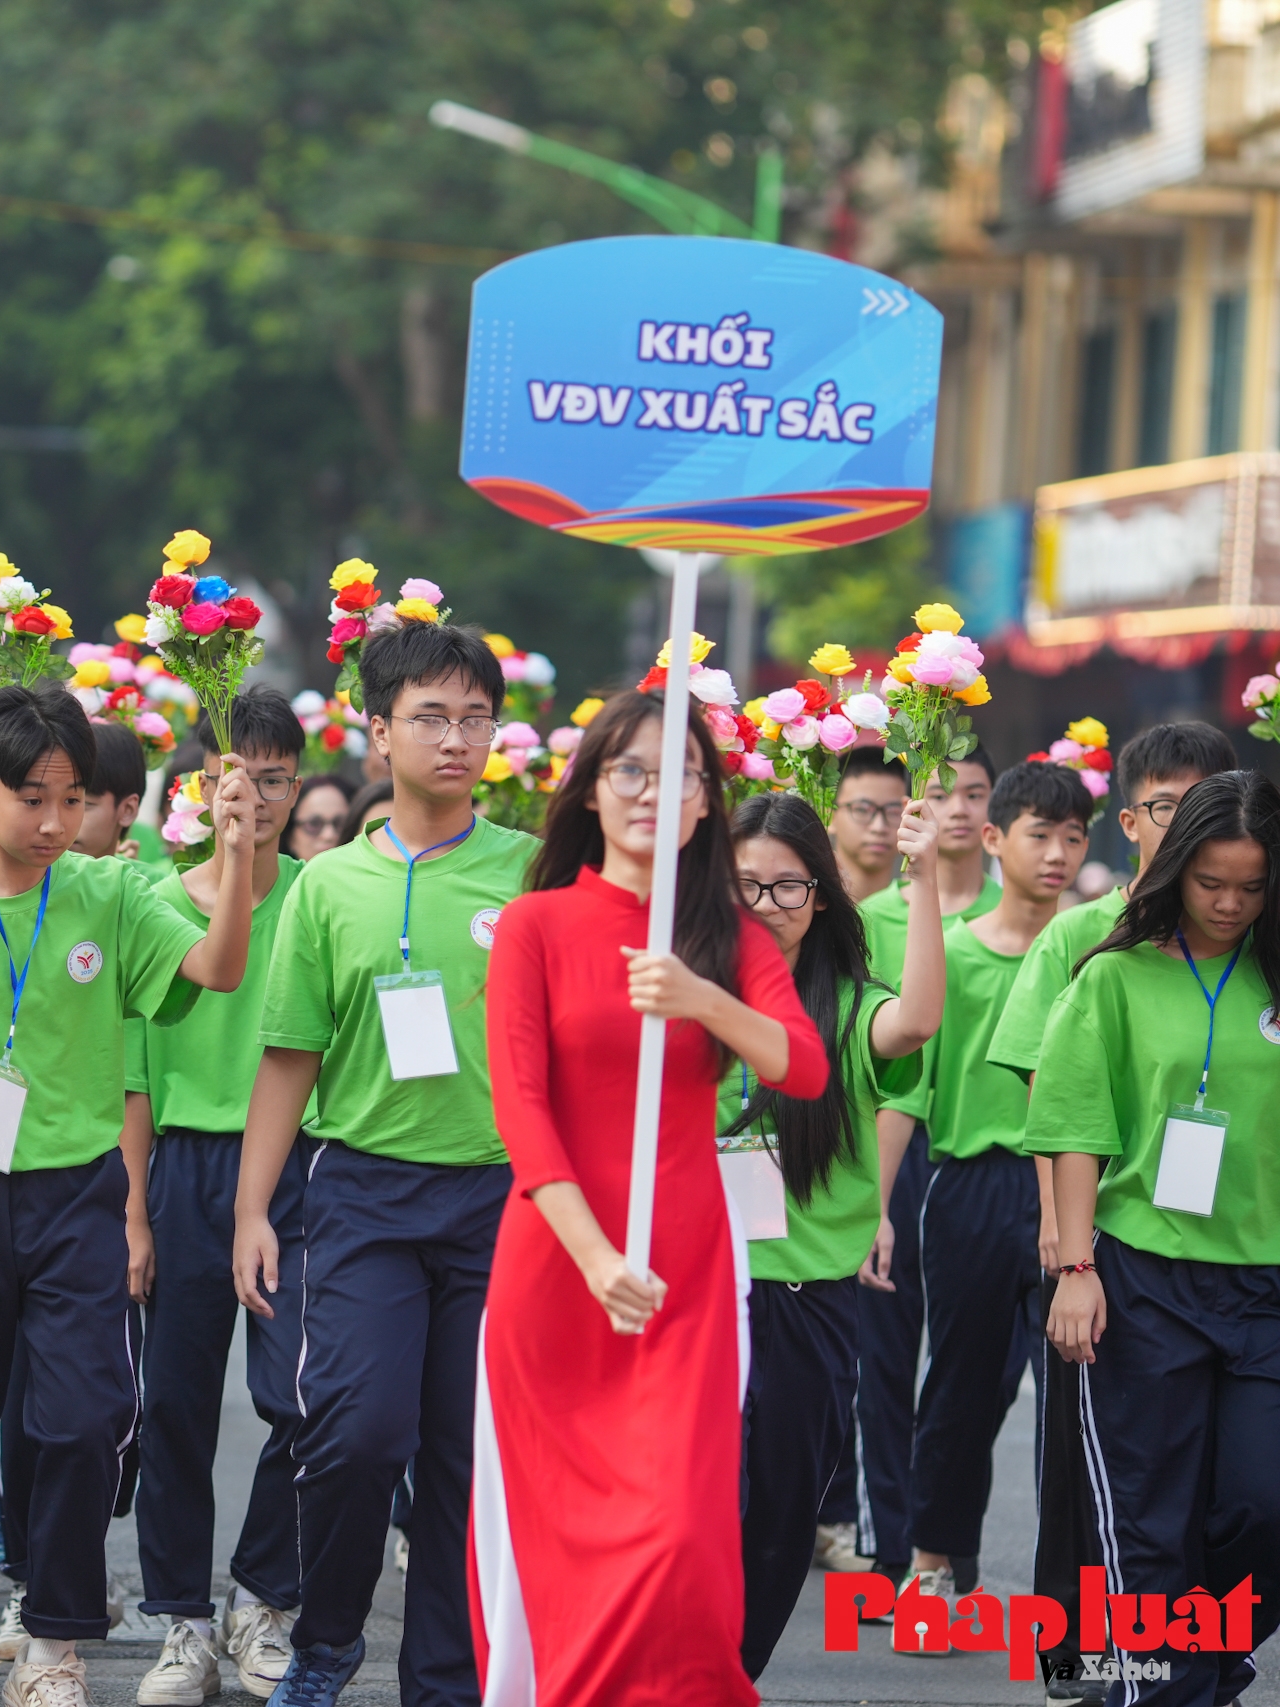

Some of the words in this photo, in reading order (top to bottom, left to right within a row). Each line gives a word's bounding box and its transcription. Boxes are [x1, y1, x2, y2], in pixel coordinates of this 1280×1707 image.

[638, 313, 773, 368] KHỐI
[528, 381, 631, 425] VĐV
[637, 381, 771, 436] XUẤT
[778, 380, 874, 443] SẮC
